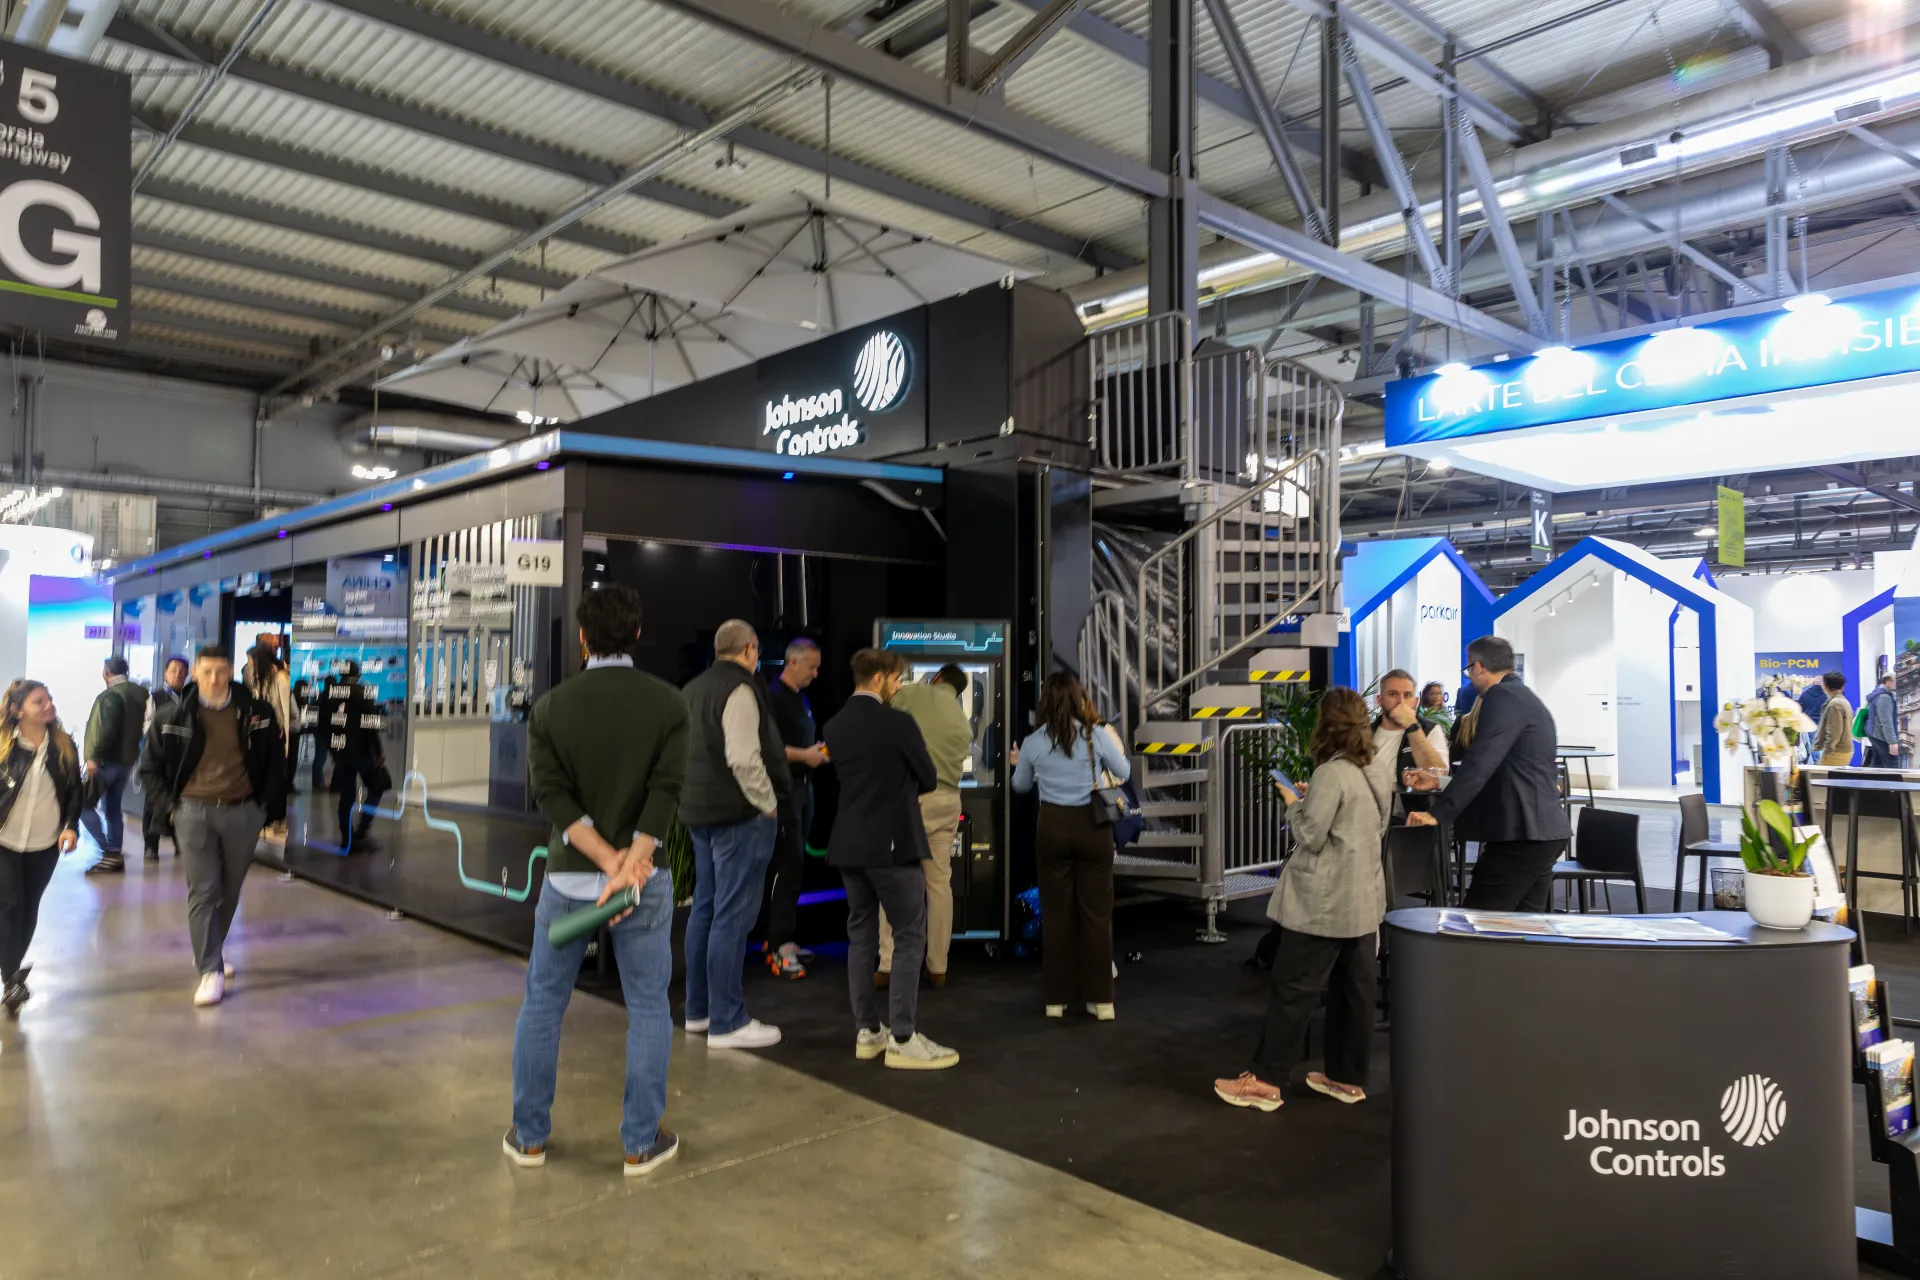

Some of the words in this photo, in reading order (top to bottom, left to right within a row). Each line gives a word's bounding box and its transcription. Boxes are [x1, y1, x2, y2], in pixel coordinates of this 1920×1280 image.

[17, 67, 60, 124] 5
[0, 122, 45, 150] orsia
[0, 140, 72, 174] angway
[0, 179, 101, 294] G
[763, 388, 843, 436] Johnson
[776, 413, 859, 456] Controls
[1534, 509, 1549, 546] K
[517, 554, 550, 572] G19
[1421, 604, 1459, 623] parkair
[892, 631, 932, 641] Innovation
[932, 631, 957, 641] Studio
[1759, 658, 1819, 669] Bio-PCM
[1563, 1108, 1700, 1141] Johnson
[1589, 1145, 1726, 1177] Controls
